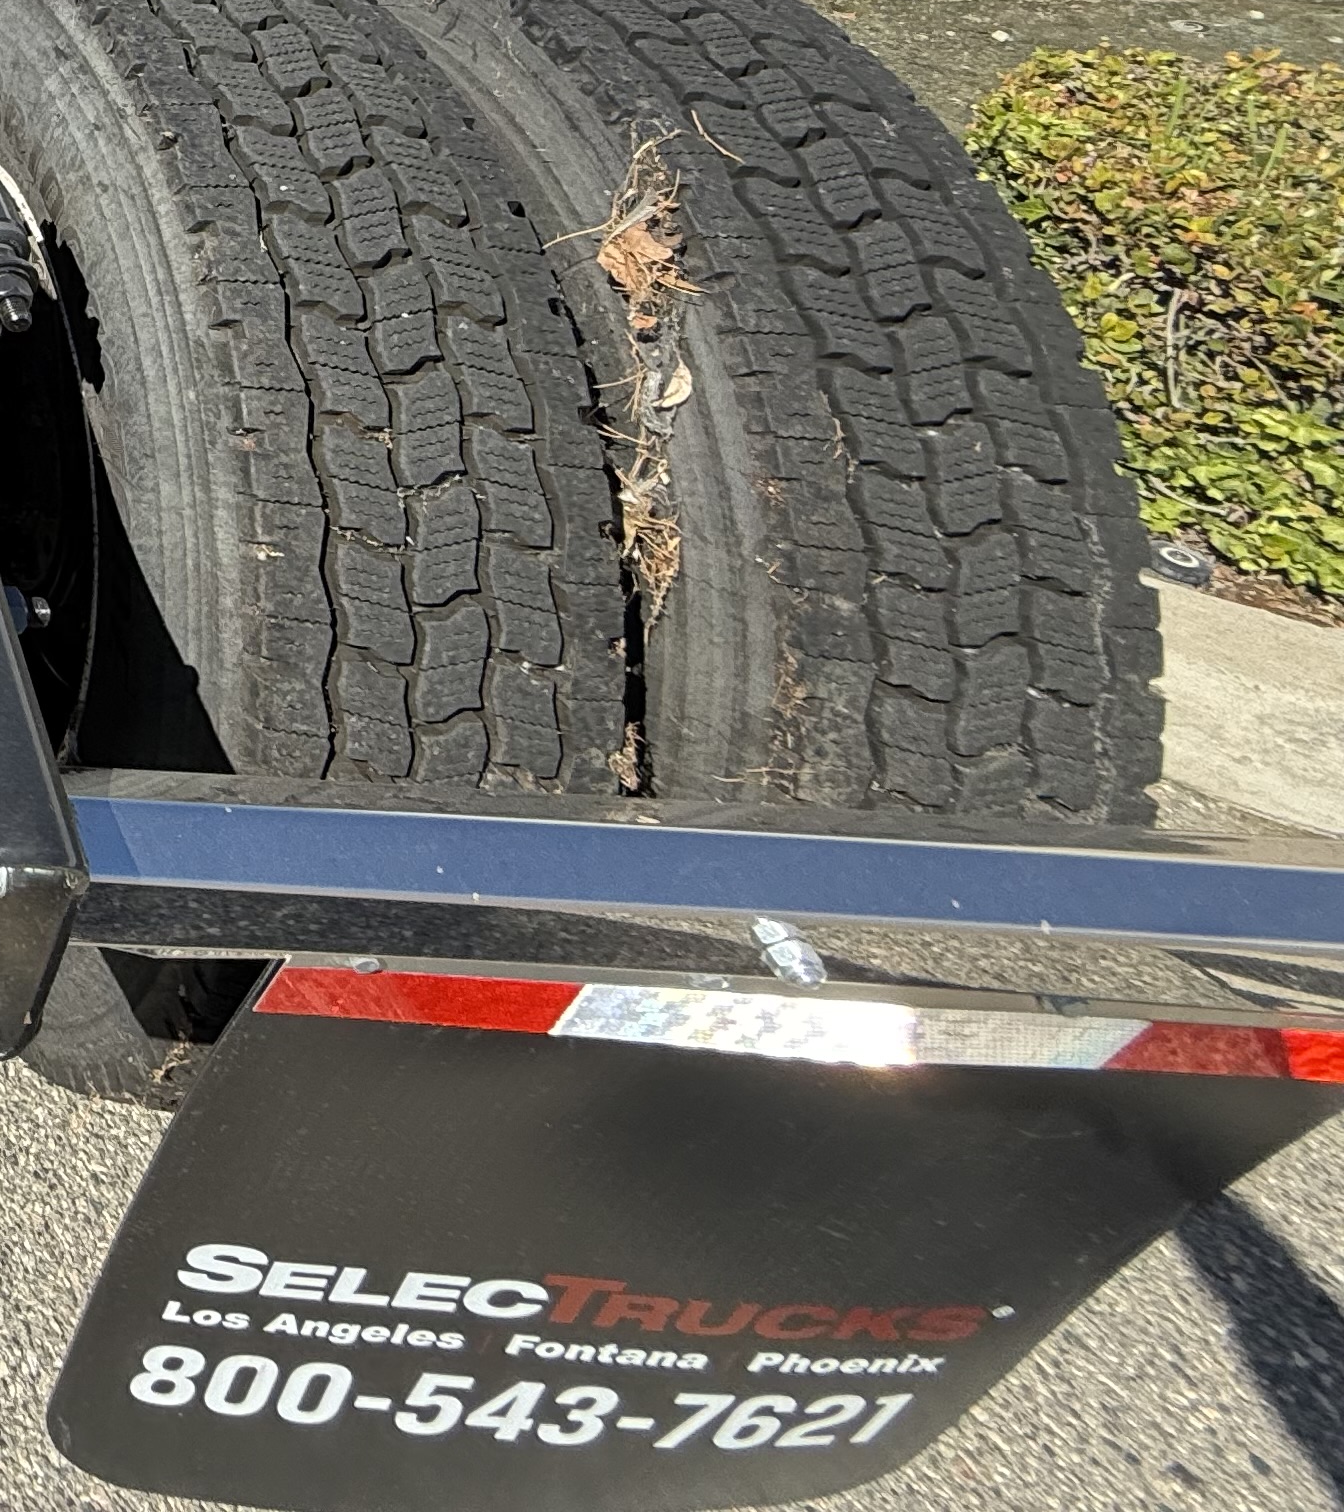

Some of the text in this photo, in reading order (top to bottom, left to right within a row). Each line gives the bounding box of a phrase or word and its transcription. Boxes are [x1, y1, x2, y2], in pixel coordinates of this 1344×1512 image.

[161, 1301, 946, 1375] Los Angeles Fontana Phoenix
[129, 1345, 915, 1450] 800-543-7621
